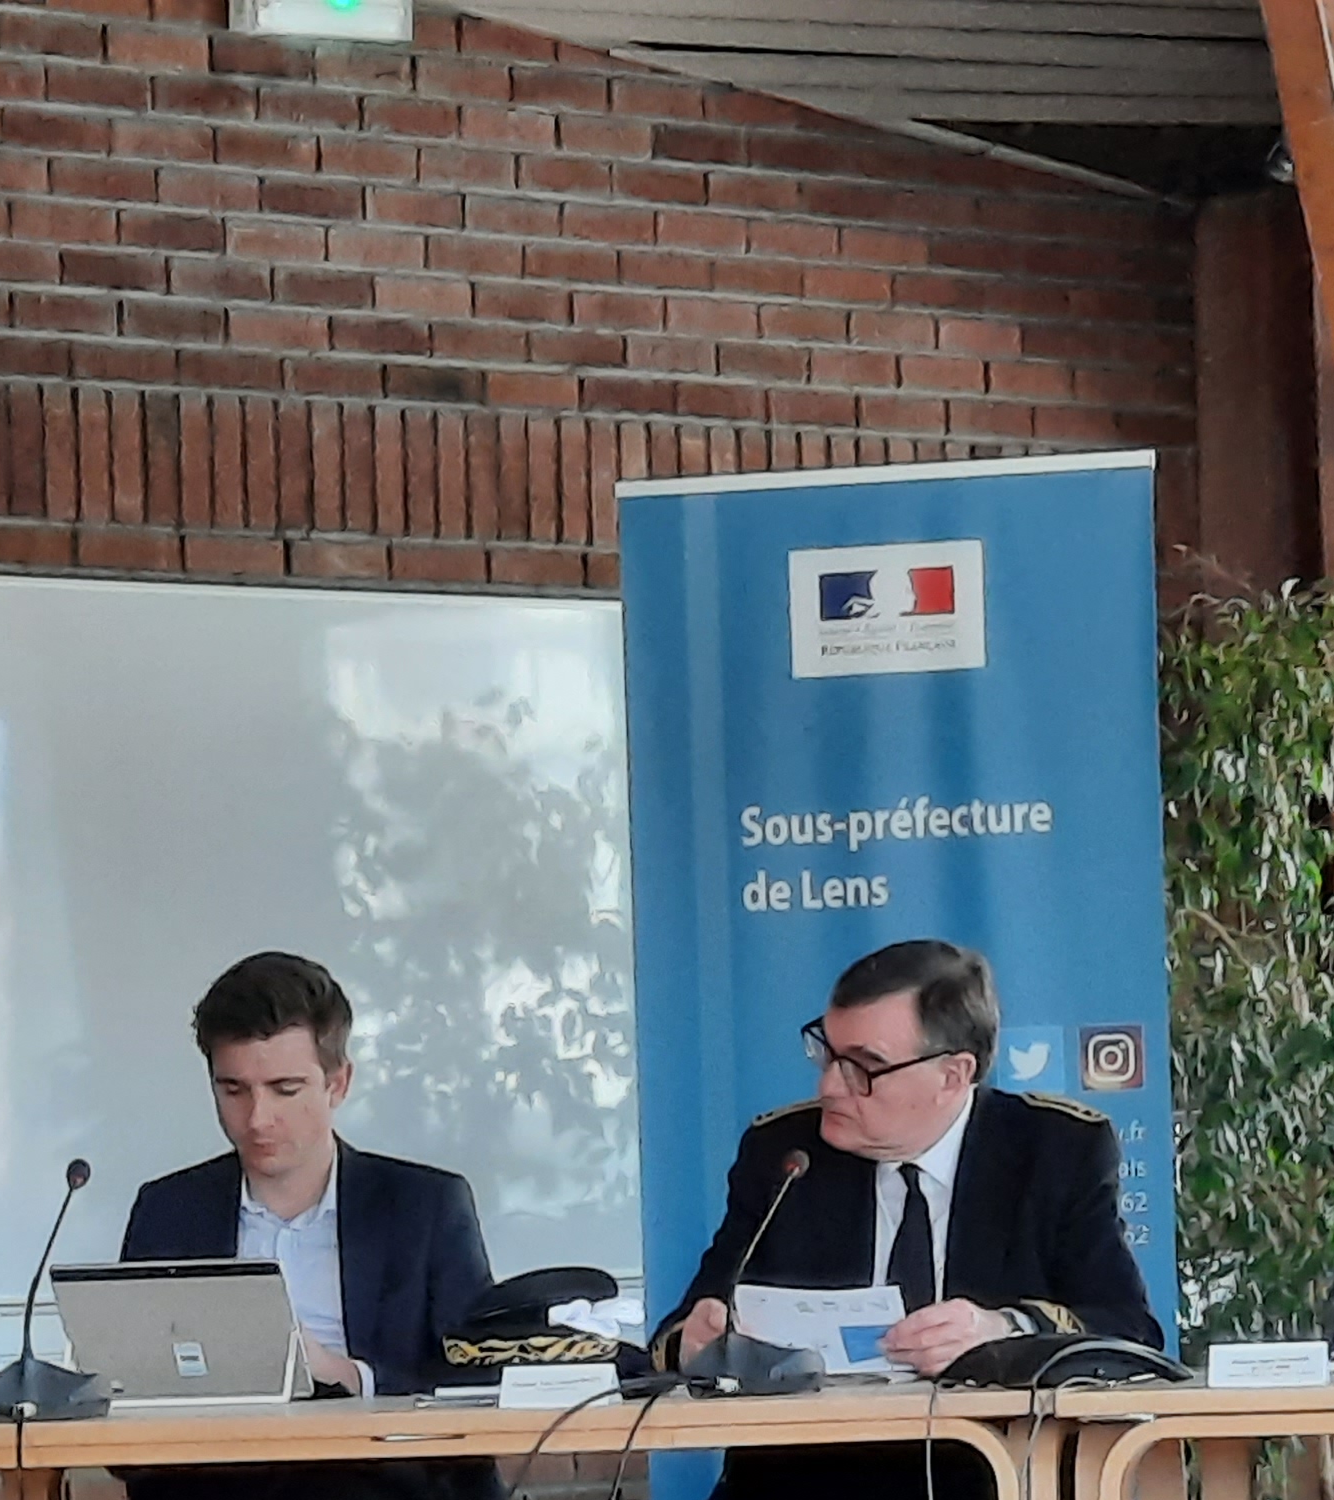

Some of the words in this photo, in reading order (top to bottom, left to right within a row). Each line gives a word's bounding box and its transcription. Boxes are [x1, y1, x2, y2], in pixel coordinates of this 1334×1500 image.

[739, 795, 1053, 852] Sous-préfecture
[742, 867, 792, 912] de
[801, 869, 890, 911] Lens
